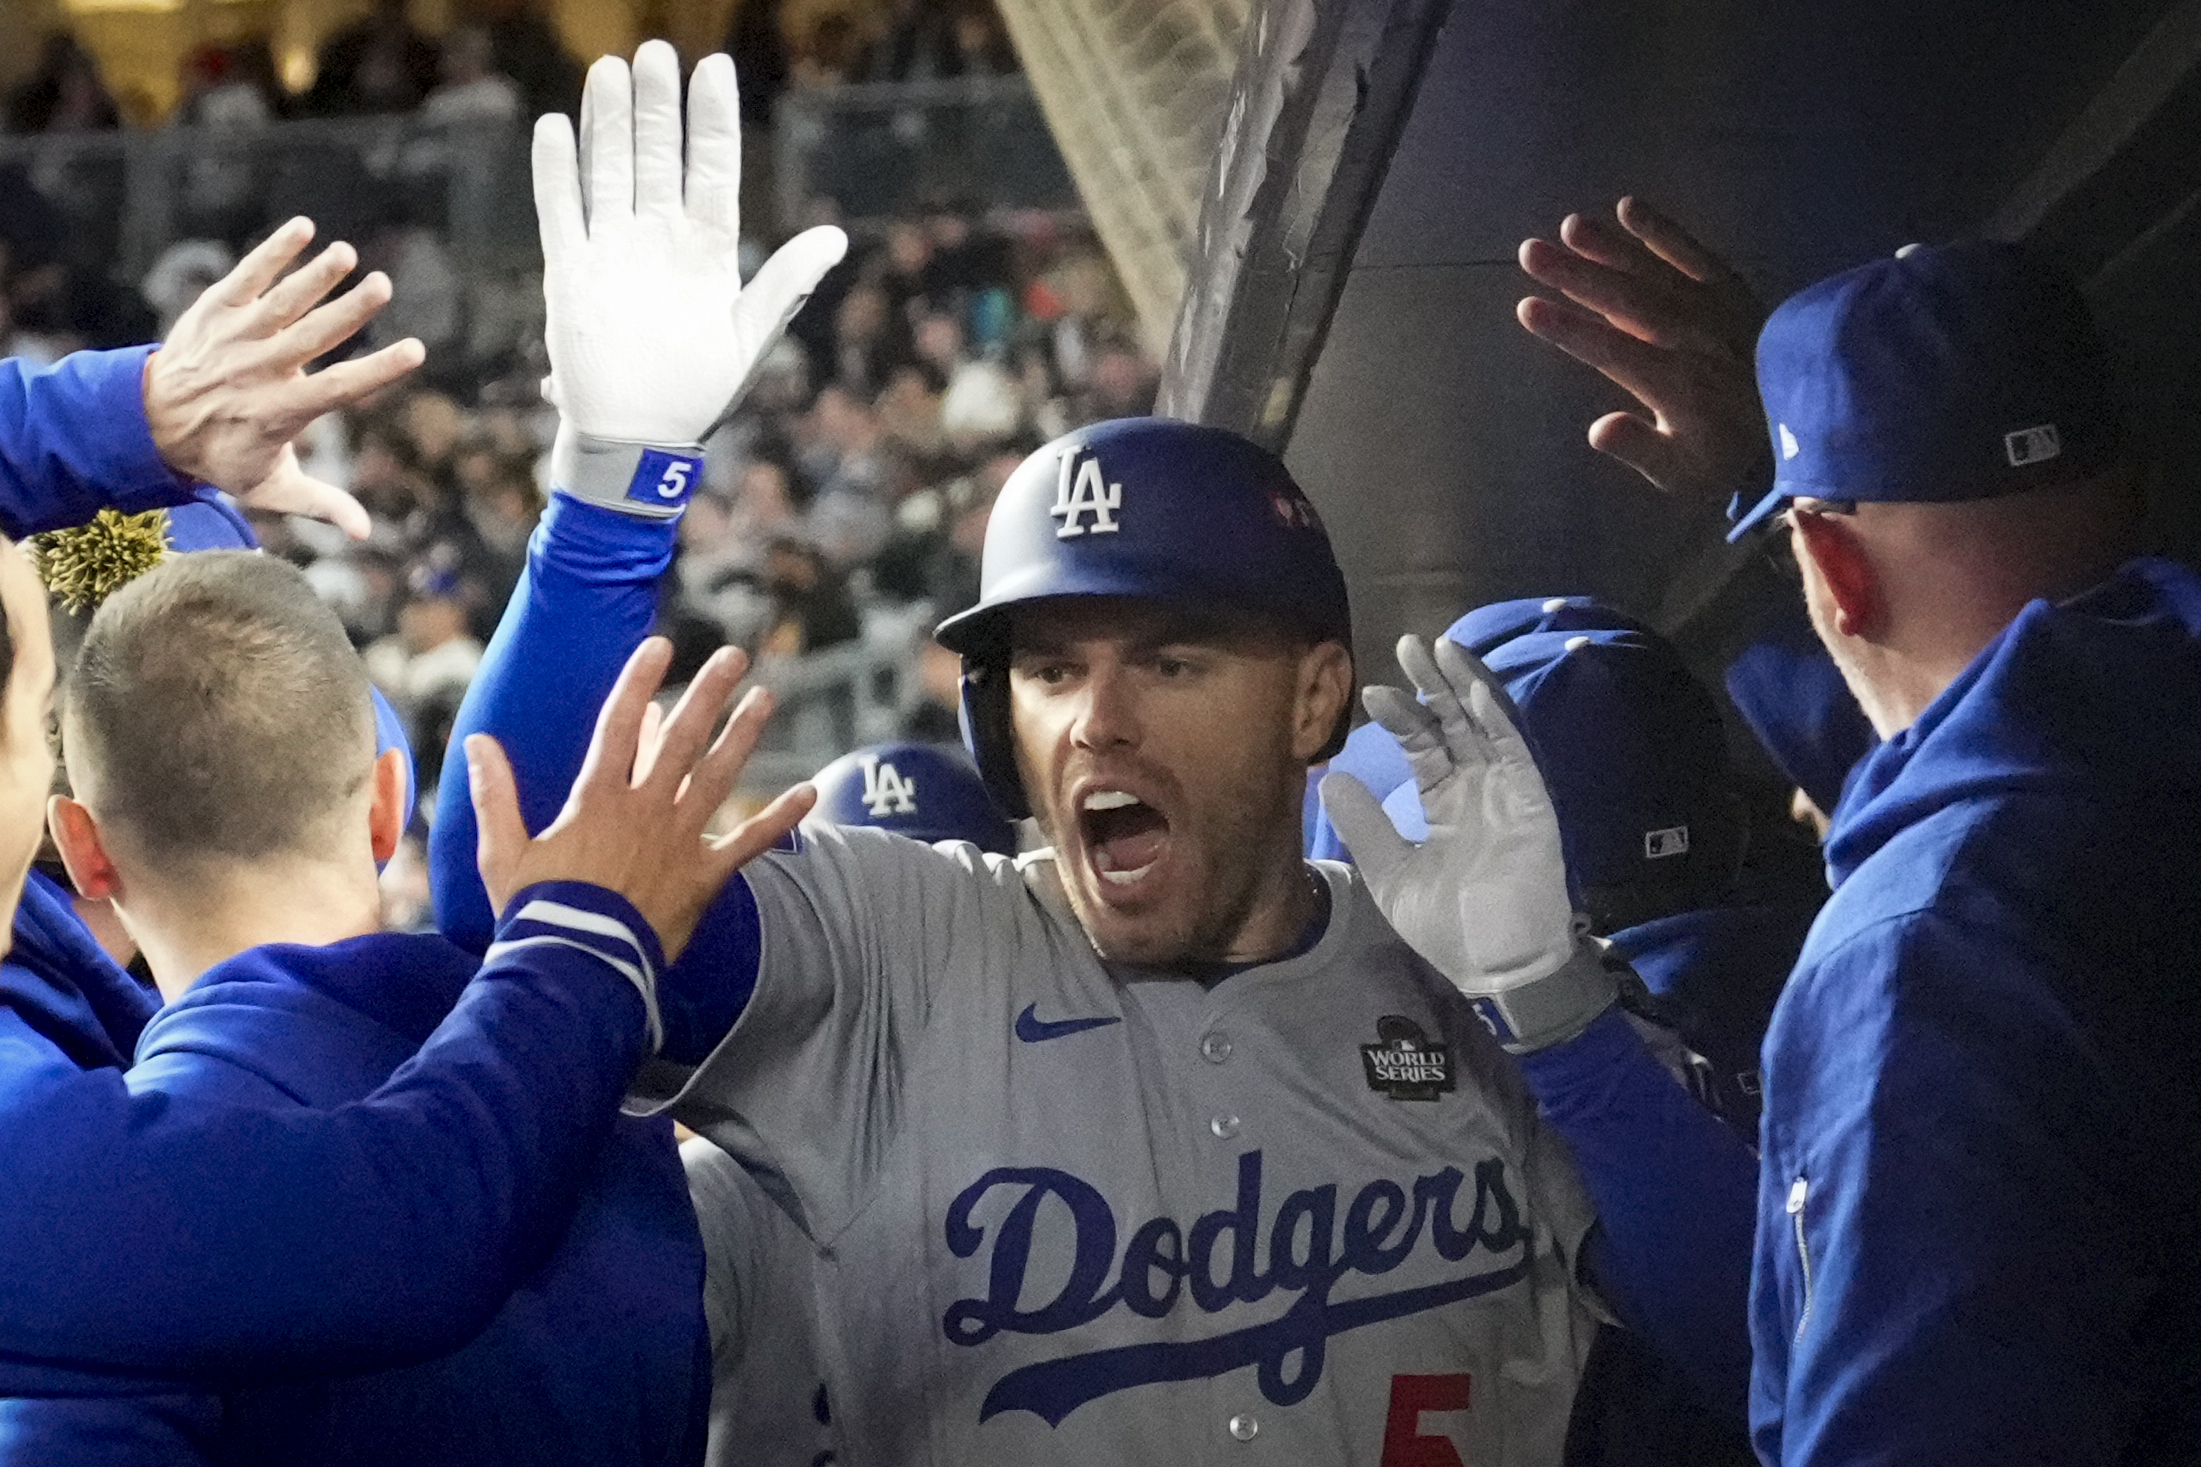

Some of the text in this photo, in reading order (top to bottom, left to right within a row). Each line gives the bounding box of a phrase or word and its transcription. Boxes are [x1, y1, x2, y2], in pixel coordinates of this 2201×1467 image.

[657, 460, 692, 498] 5
[1050, 445, 1122, 538] LA
[859, 753, 916, 816] LA
[1367, 1050, 1446, 1067] WORLD
[1375, 1065, 1446, 1083] SERIES
[943, 1149, 1532, 1407] Dodgers
